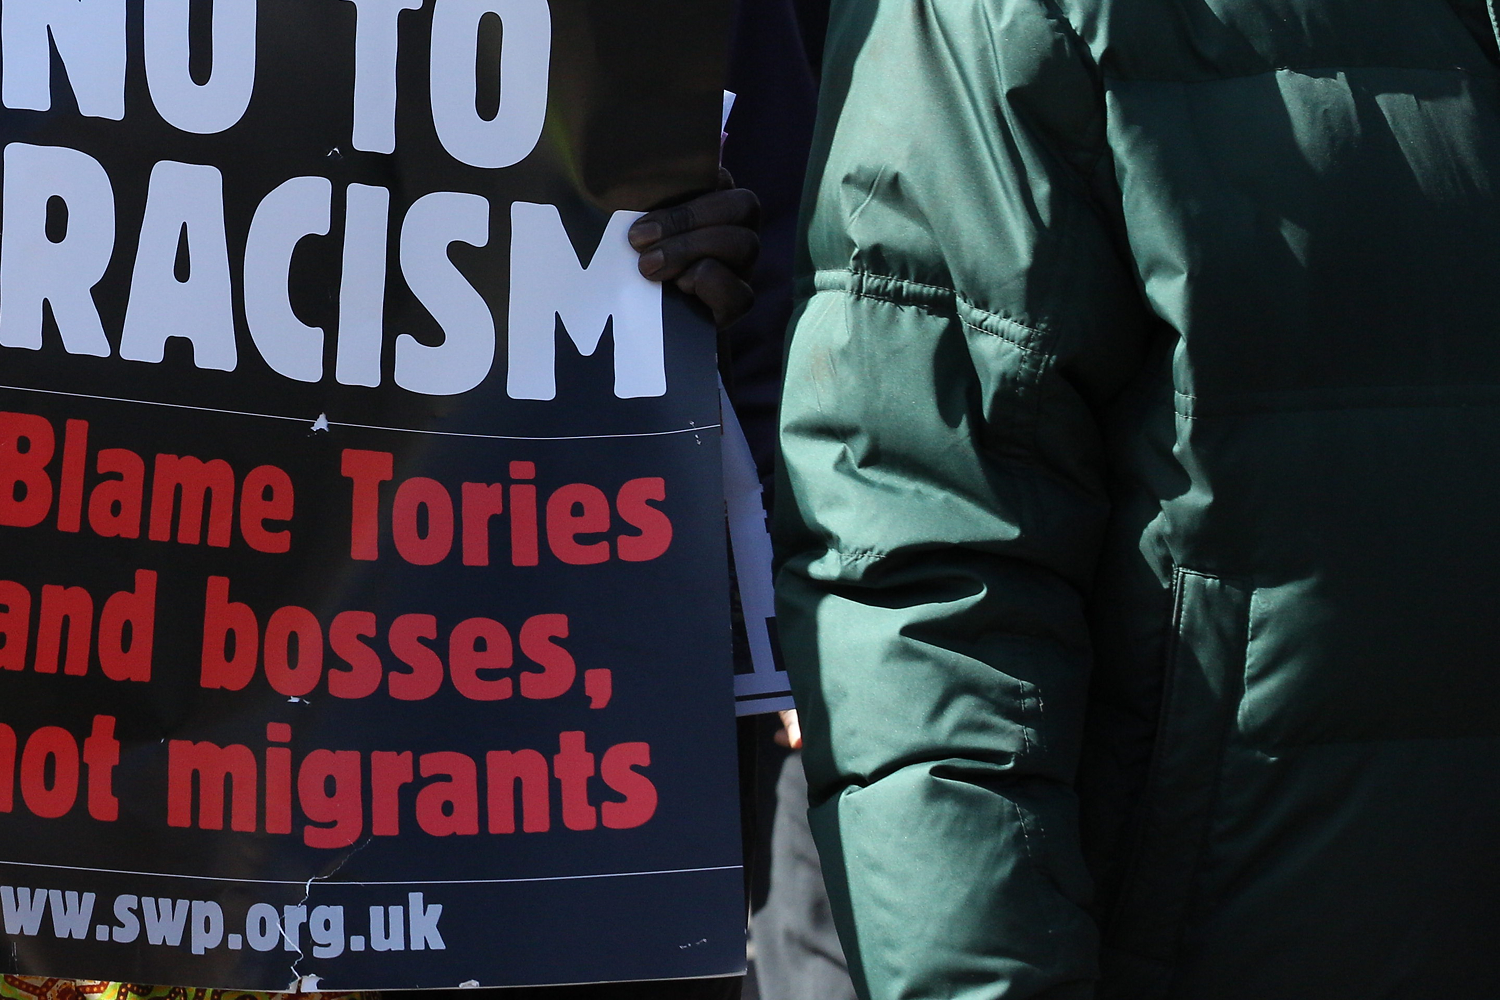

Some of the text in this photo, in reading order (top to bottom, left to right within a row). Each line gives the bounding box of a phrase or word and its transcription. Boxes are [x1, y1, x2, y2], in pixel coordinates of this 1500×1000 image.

[339, 447, 675, 568] Tories
[198, 574, 614, 711] bosses,
[166, 720, 660, 850] migrants
